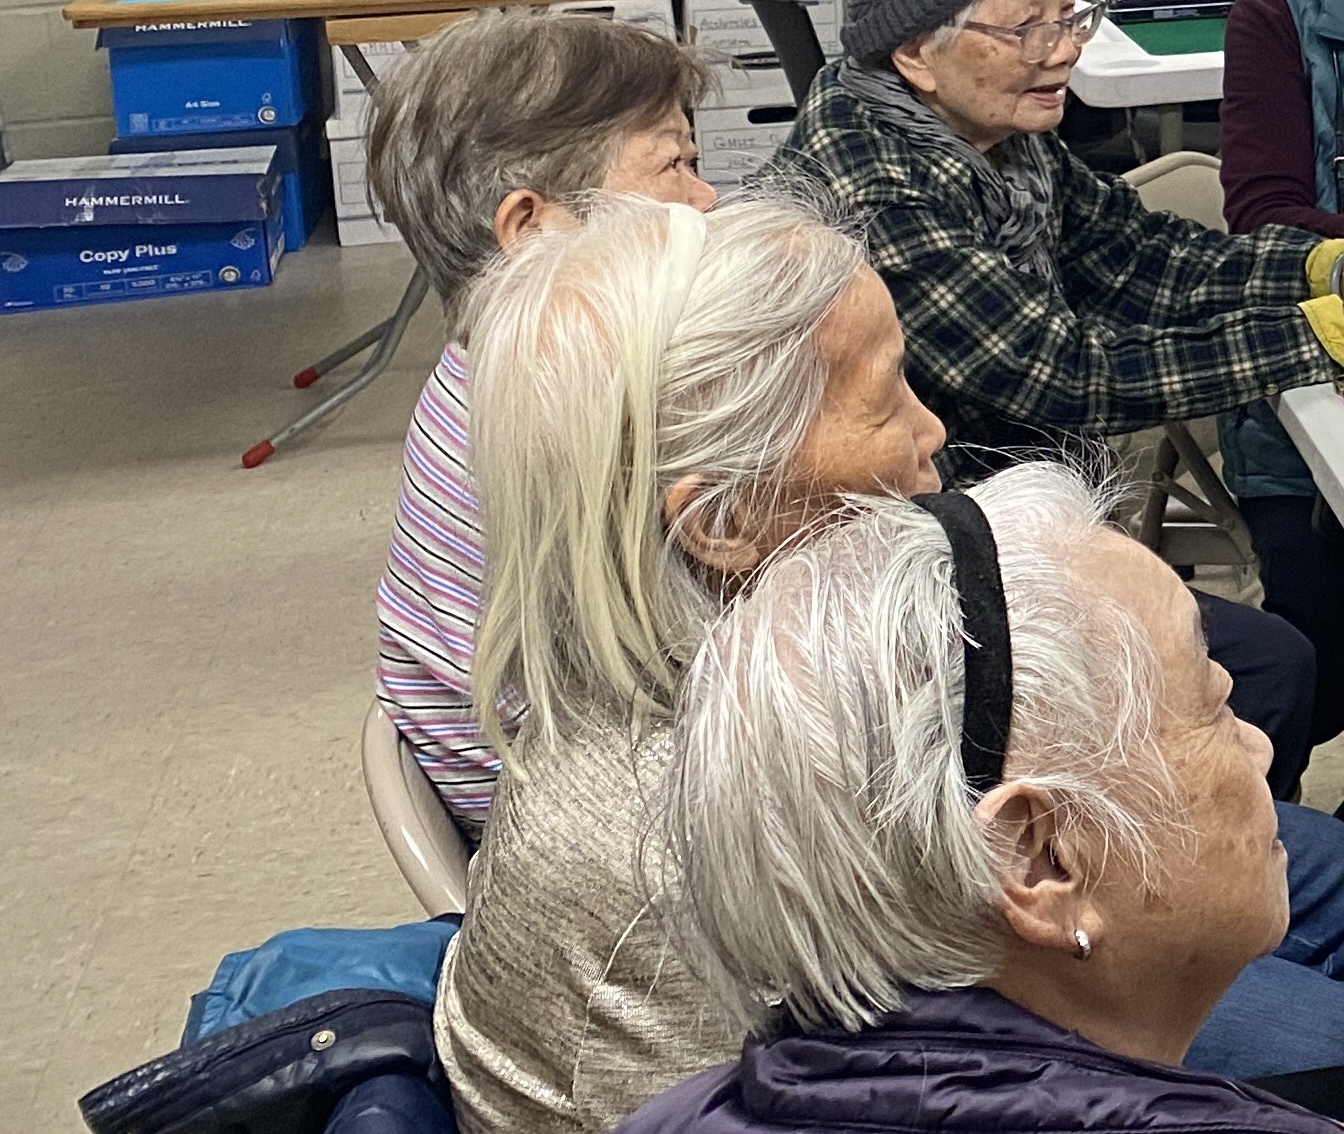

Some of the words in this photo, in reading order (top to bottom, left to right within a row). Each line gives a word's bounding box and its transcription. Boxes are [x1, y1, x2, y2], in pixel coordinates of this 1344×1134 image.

[135, 19, 251, 32] HAMMERMILL
[65, 194, 187, 207] HAMMERMILL
[79, 250, 130, 264] Copy
[135, 243, 178, 257] Plus
